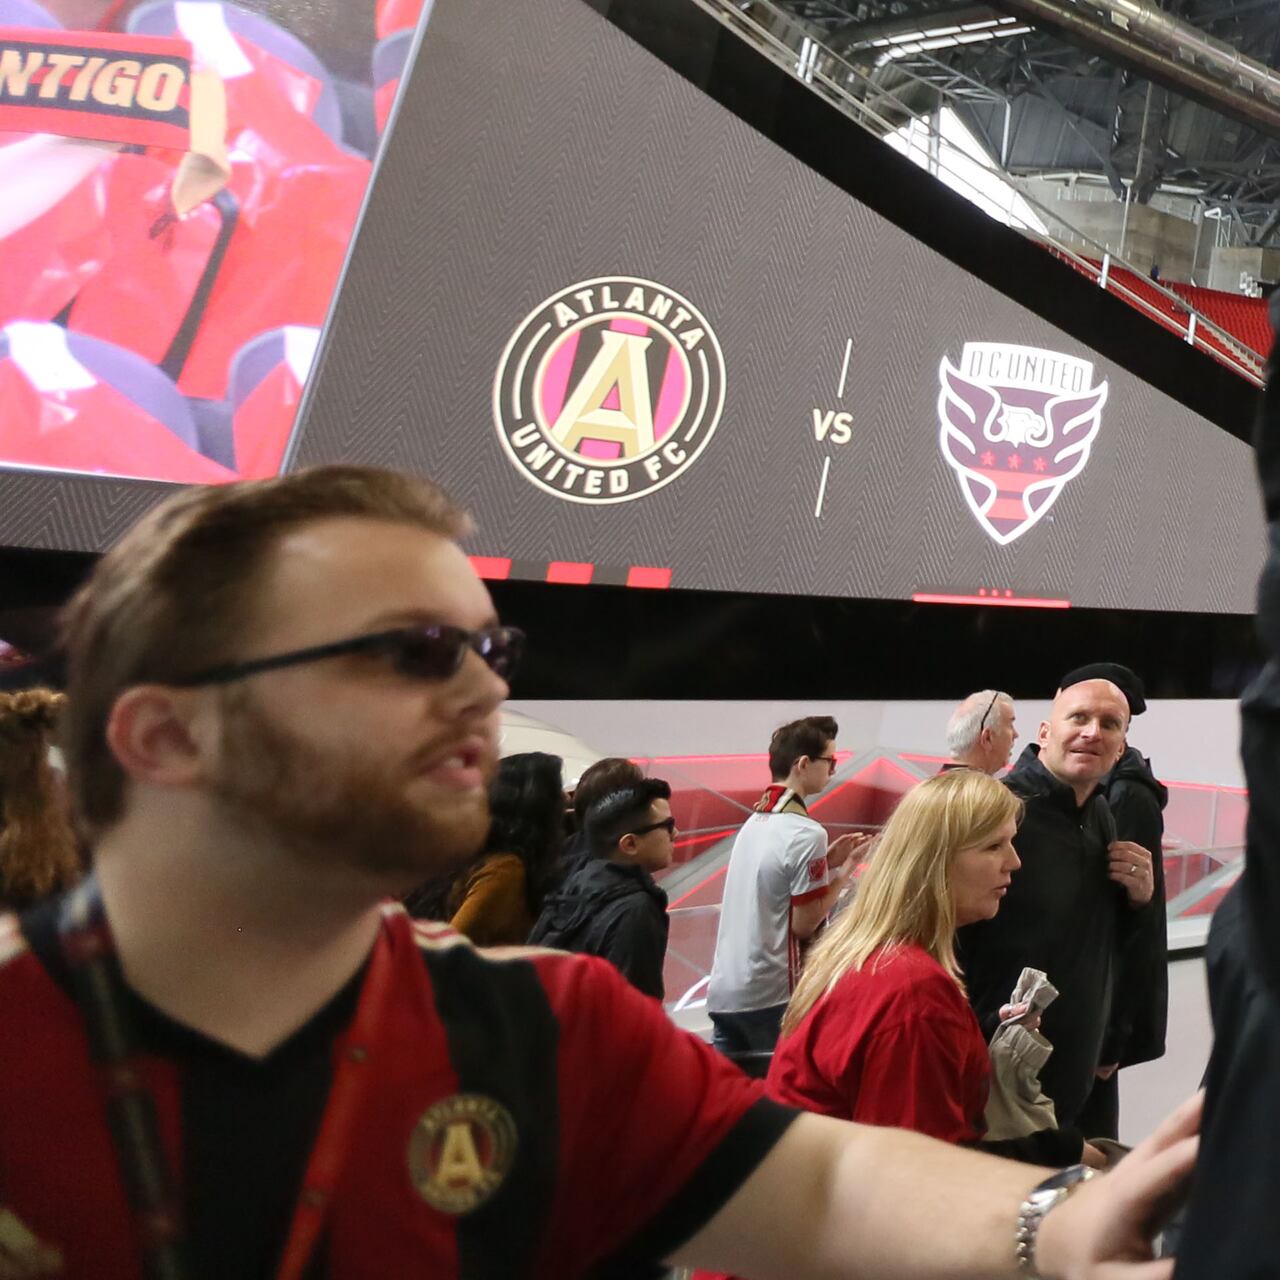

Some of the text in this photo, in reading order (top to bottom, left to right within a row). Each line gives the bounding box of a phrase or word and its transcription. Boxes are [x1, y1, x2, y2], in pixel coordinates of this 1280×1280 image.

[552, 286, 706, 352] ATLANTA
[1007, 352, 1084, 395] UNITED
[812, 408, 853, 445] VS
[511, 423, 690, 494] UNITED FC
